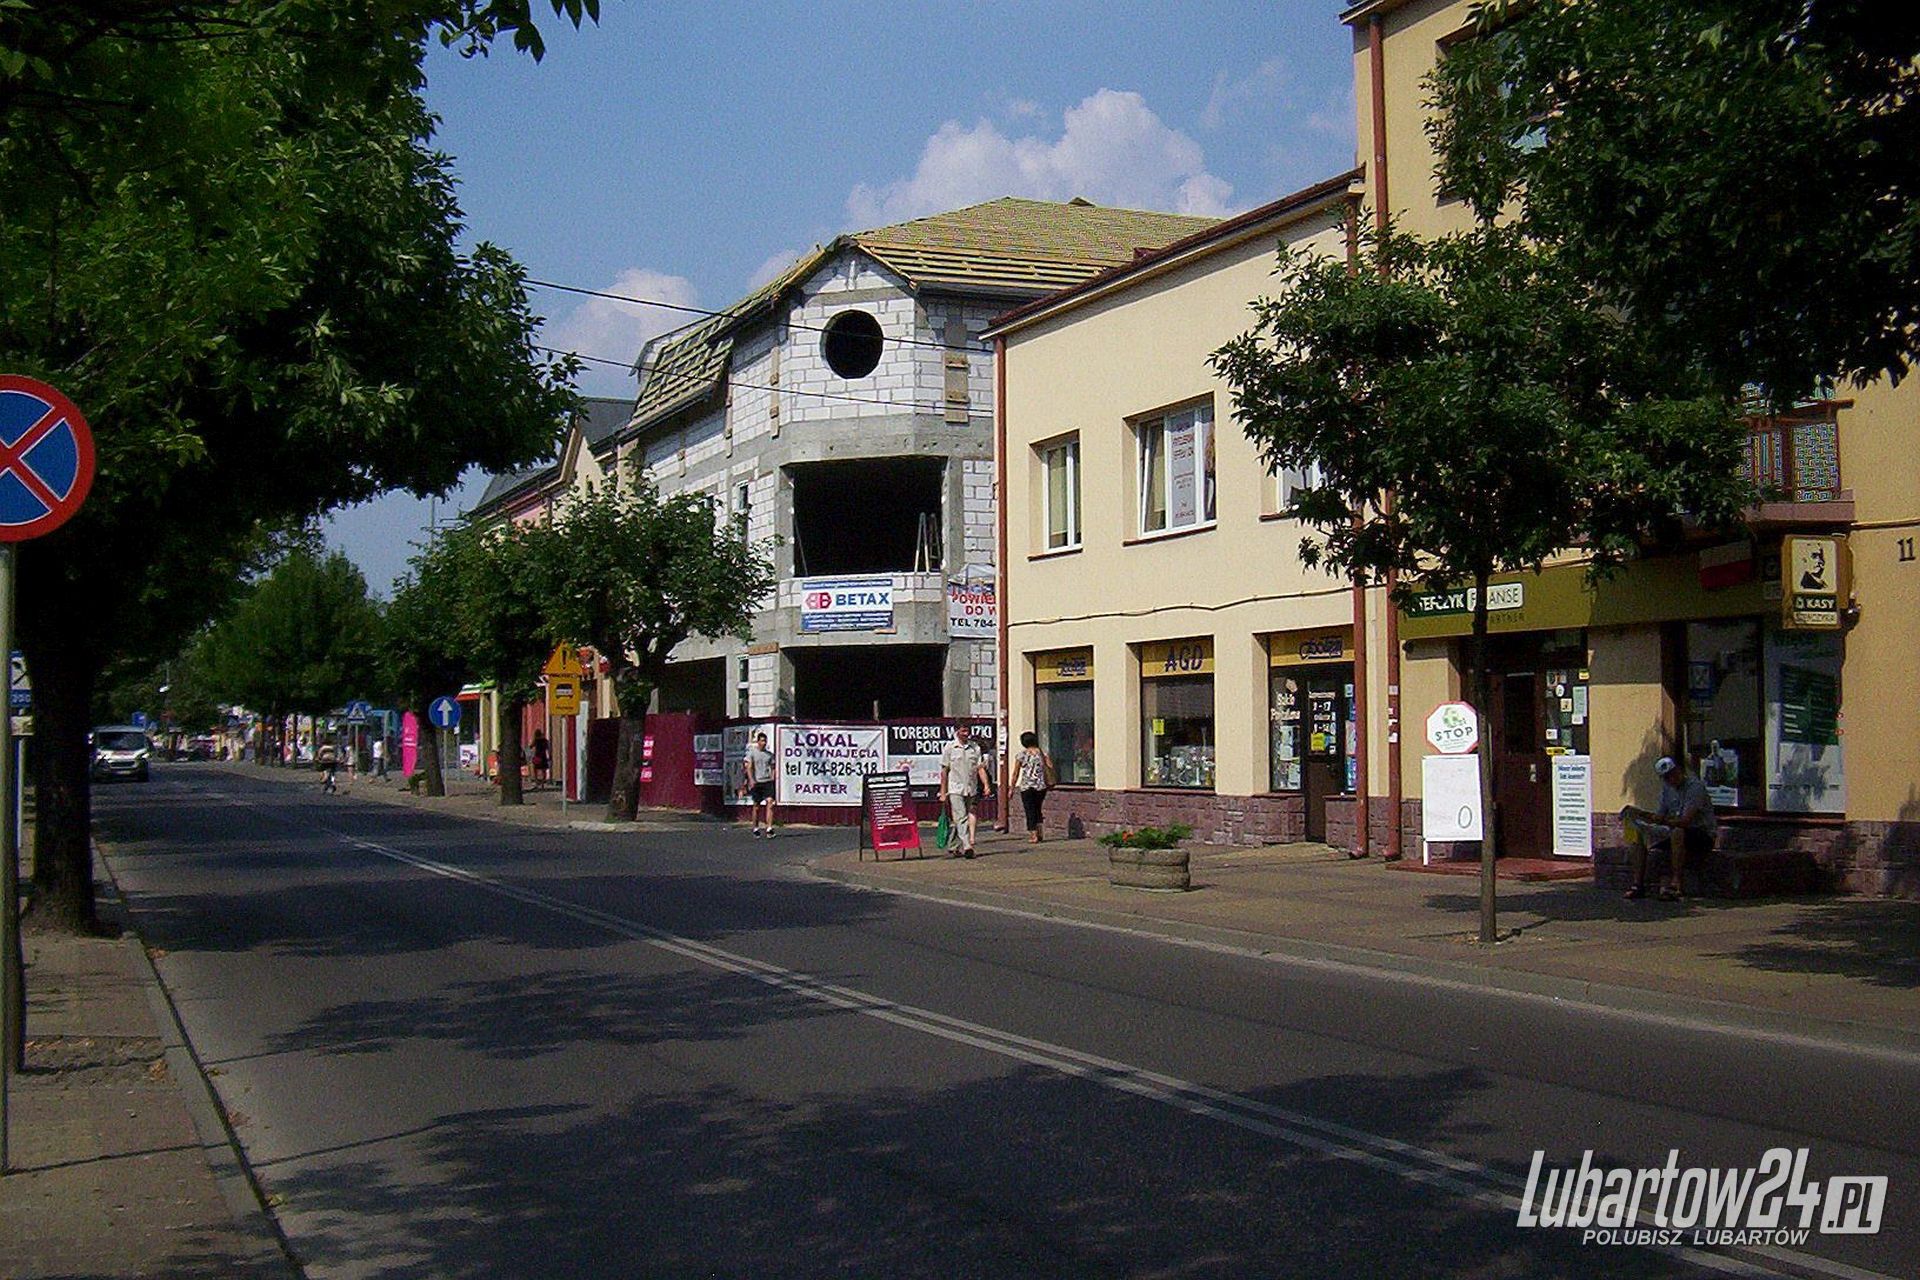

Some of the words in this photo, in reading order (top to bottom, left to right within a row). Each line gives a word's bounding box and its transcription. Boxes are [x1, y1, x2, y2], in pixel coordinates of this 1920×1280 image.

[1897, 538, 1915, 562] 11
[836, 592, 890, 606] BETAX
[1807, 599, 1834, 609] KASY
[965, 605, 984, 616] DO
[950, 617, 971, 627] TEL
[1164, 644, 1203, 672] AGD
[794, 732, 858, 748] LOKAL
[892, 726, 940, 740] TOREBKI
[1435, 726, 1473, 741] STOP
[785, 748, 802, 758] DO
[785, 762, 801, 776] tel
[806, 762, 878, 776] 784-826-318
[795, 784, 847, 795] PARTER
